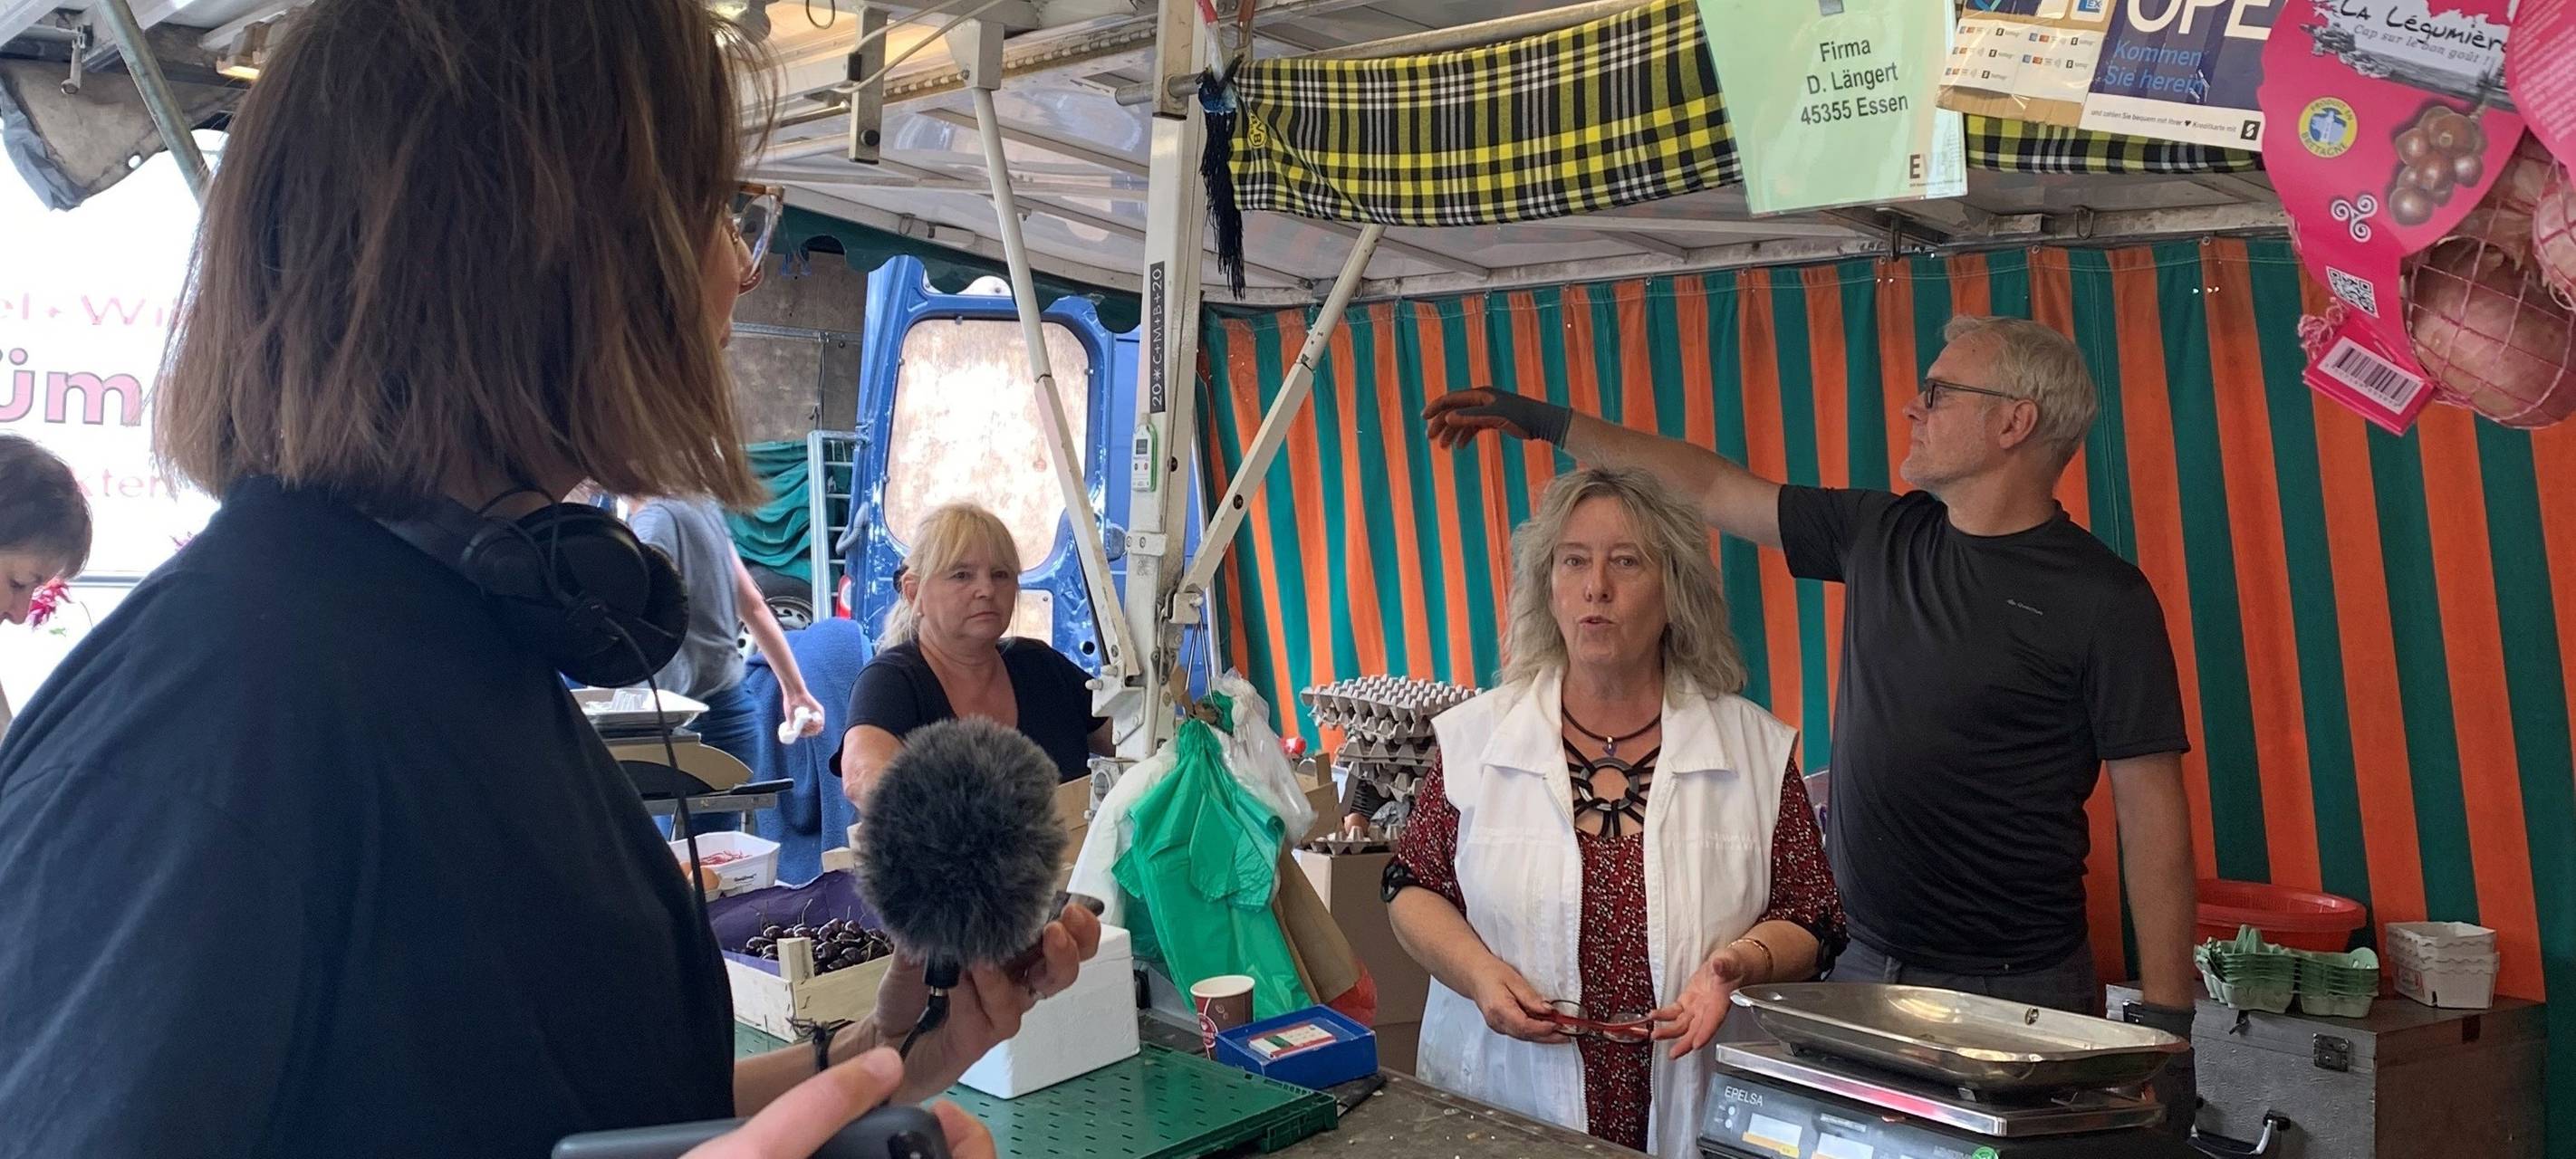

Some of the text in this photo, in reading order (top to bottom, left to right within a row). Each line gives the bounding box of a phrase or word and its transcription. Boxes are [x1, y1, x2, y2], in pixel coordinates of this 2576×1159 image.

[1819, 39, 1871, 62] Firma
[2113, 39, 2203, 67] Kommen
[2354, 24, 2378, 40] Cap
[2381, 33, 2401, 44] sur
[2448, 48, 2480, 64] goût
[1806, 62, 1898, 95] D. Längert
[2104, 64, 2135, 87] Sie
[1801, 95, 1908, 125] 45355 Essen
[1724, 1085, 1764, 1107] EPELSA
